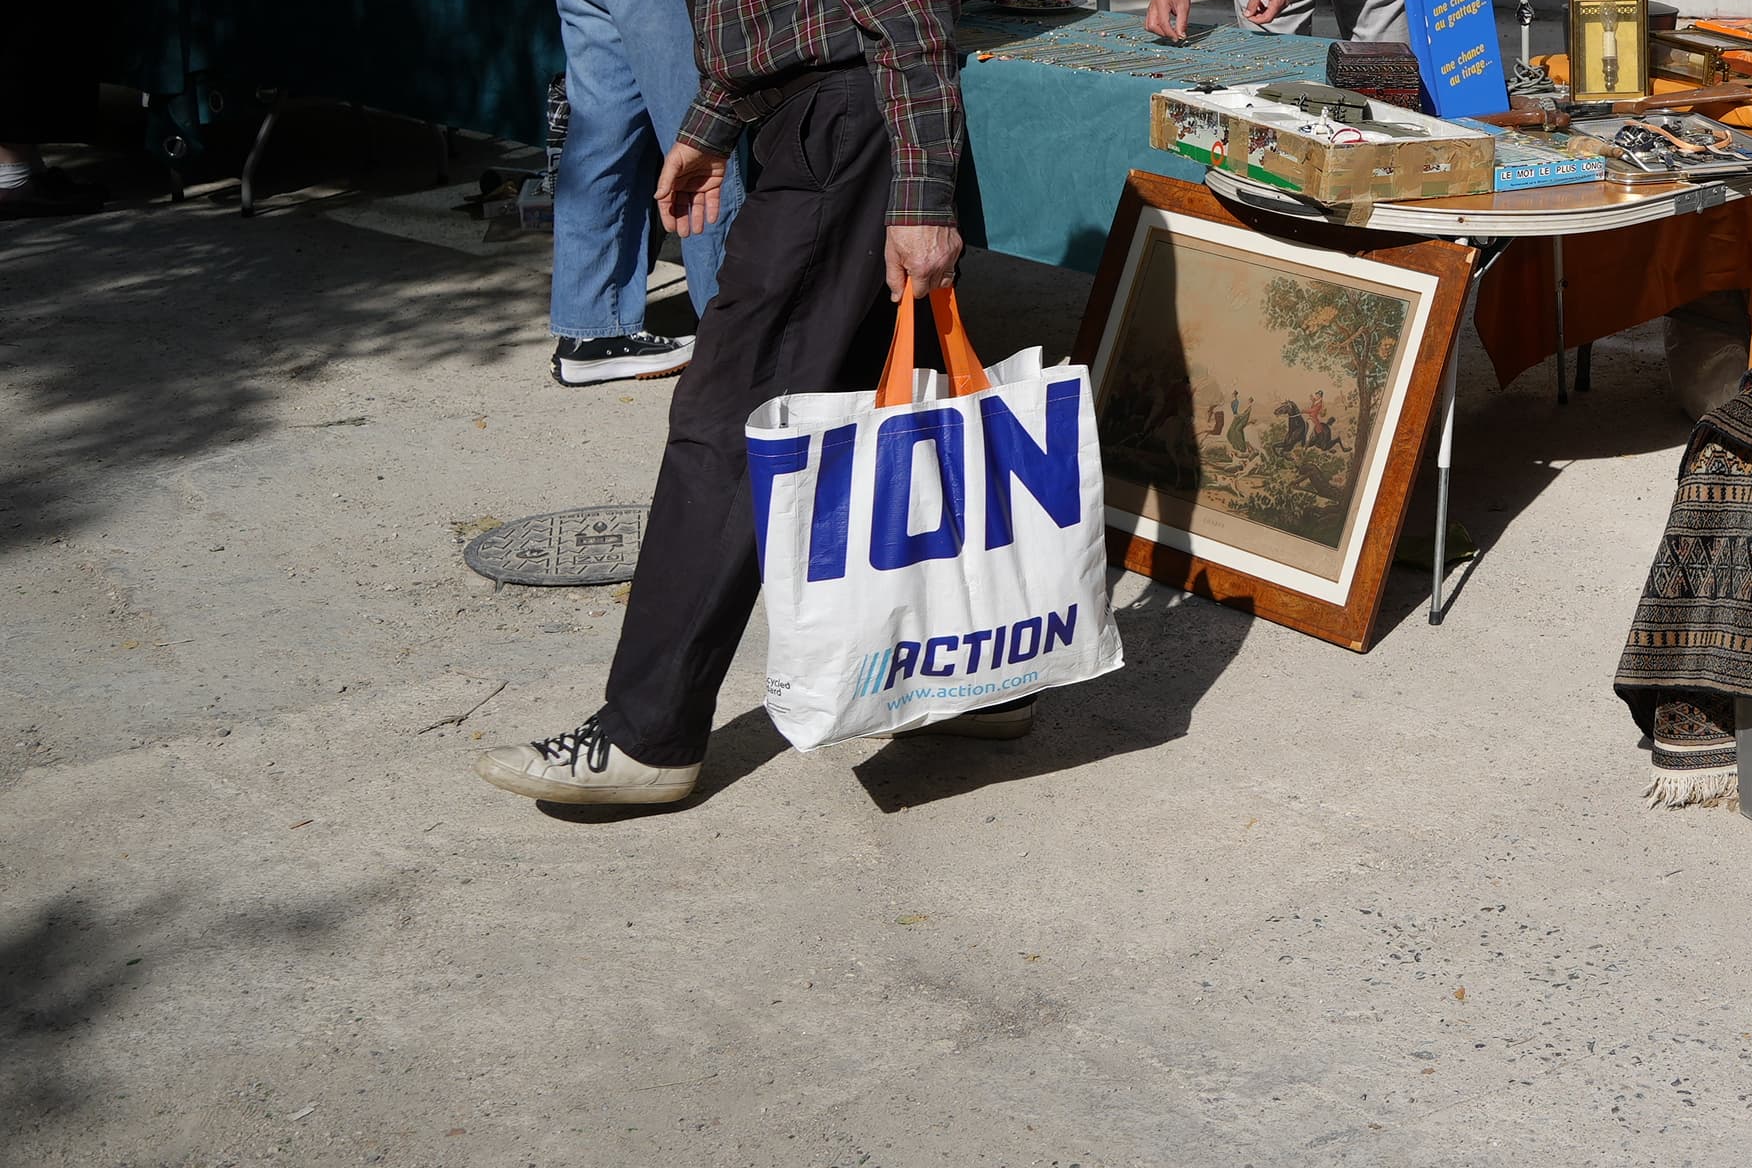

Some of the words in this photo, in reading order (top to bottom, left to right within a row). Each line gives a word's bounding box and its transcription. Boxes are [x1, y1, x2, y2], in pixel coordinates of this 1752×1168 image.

[1433, 1, 1448, 17] une
[1435, 18, 1447, 32] au
[1440, 59, 1456, 75] une
[1457, 43, 1485, 65] chance
[1449, 74, 1461, 87] au
[1501, 171, 1512, 180] LE
[1517, 169, 1534, 179] MOT
[1539, 167, 1550, 175] LE
[1556, 165, 1577, 174] PLUS
[1581, 161, 1603, 171] LONG
[884, 603, 1078, 692] ACTION
[886, 671, 1039, 712] www.action.com
